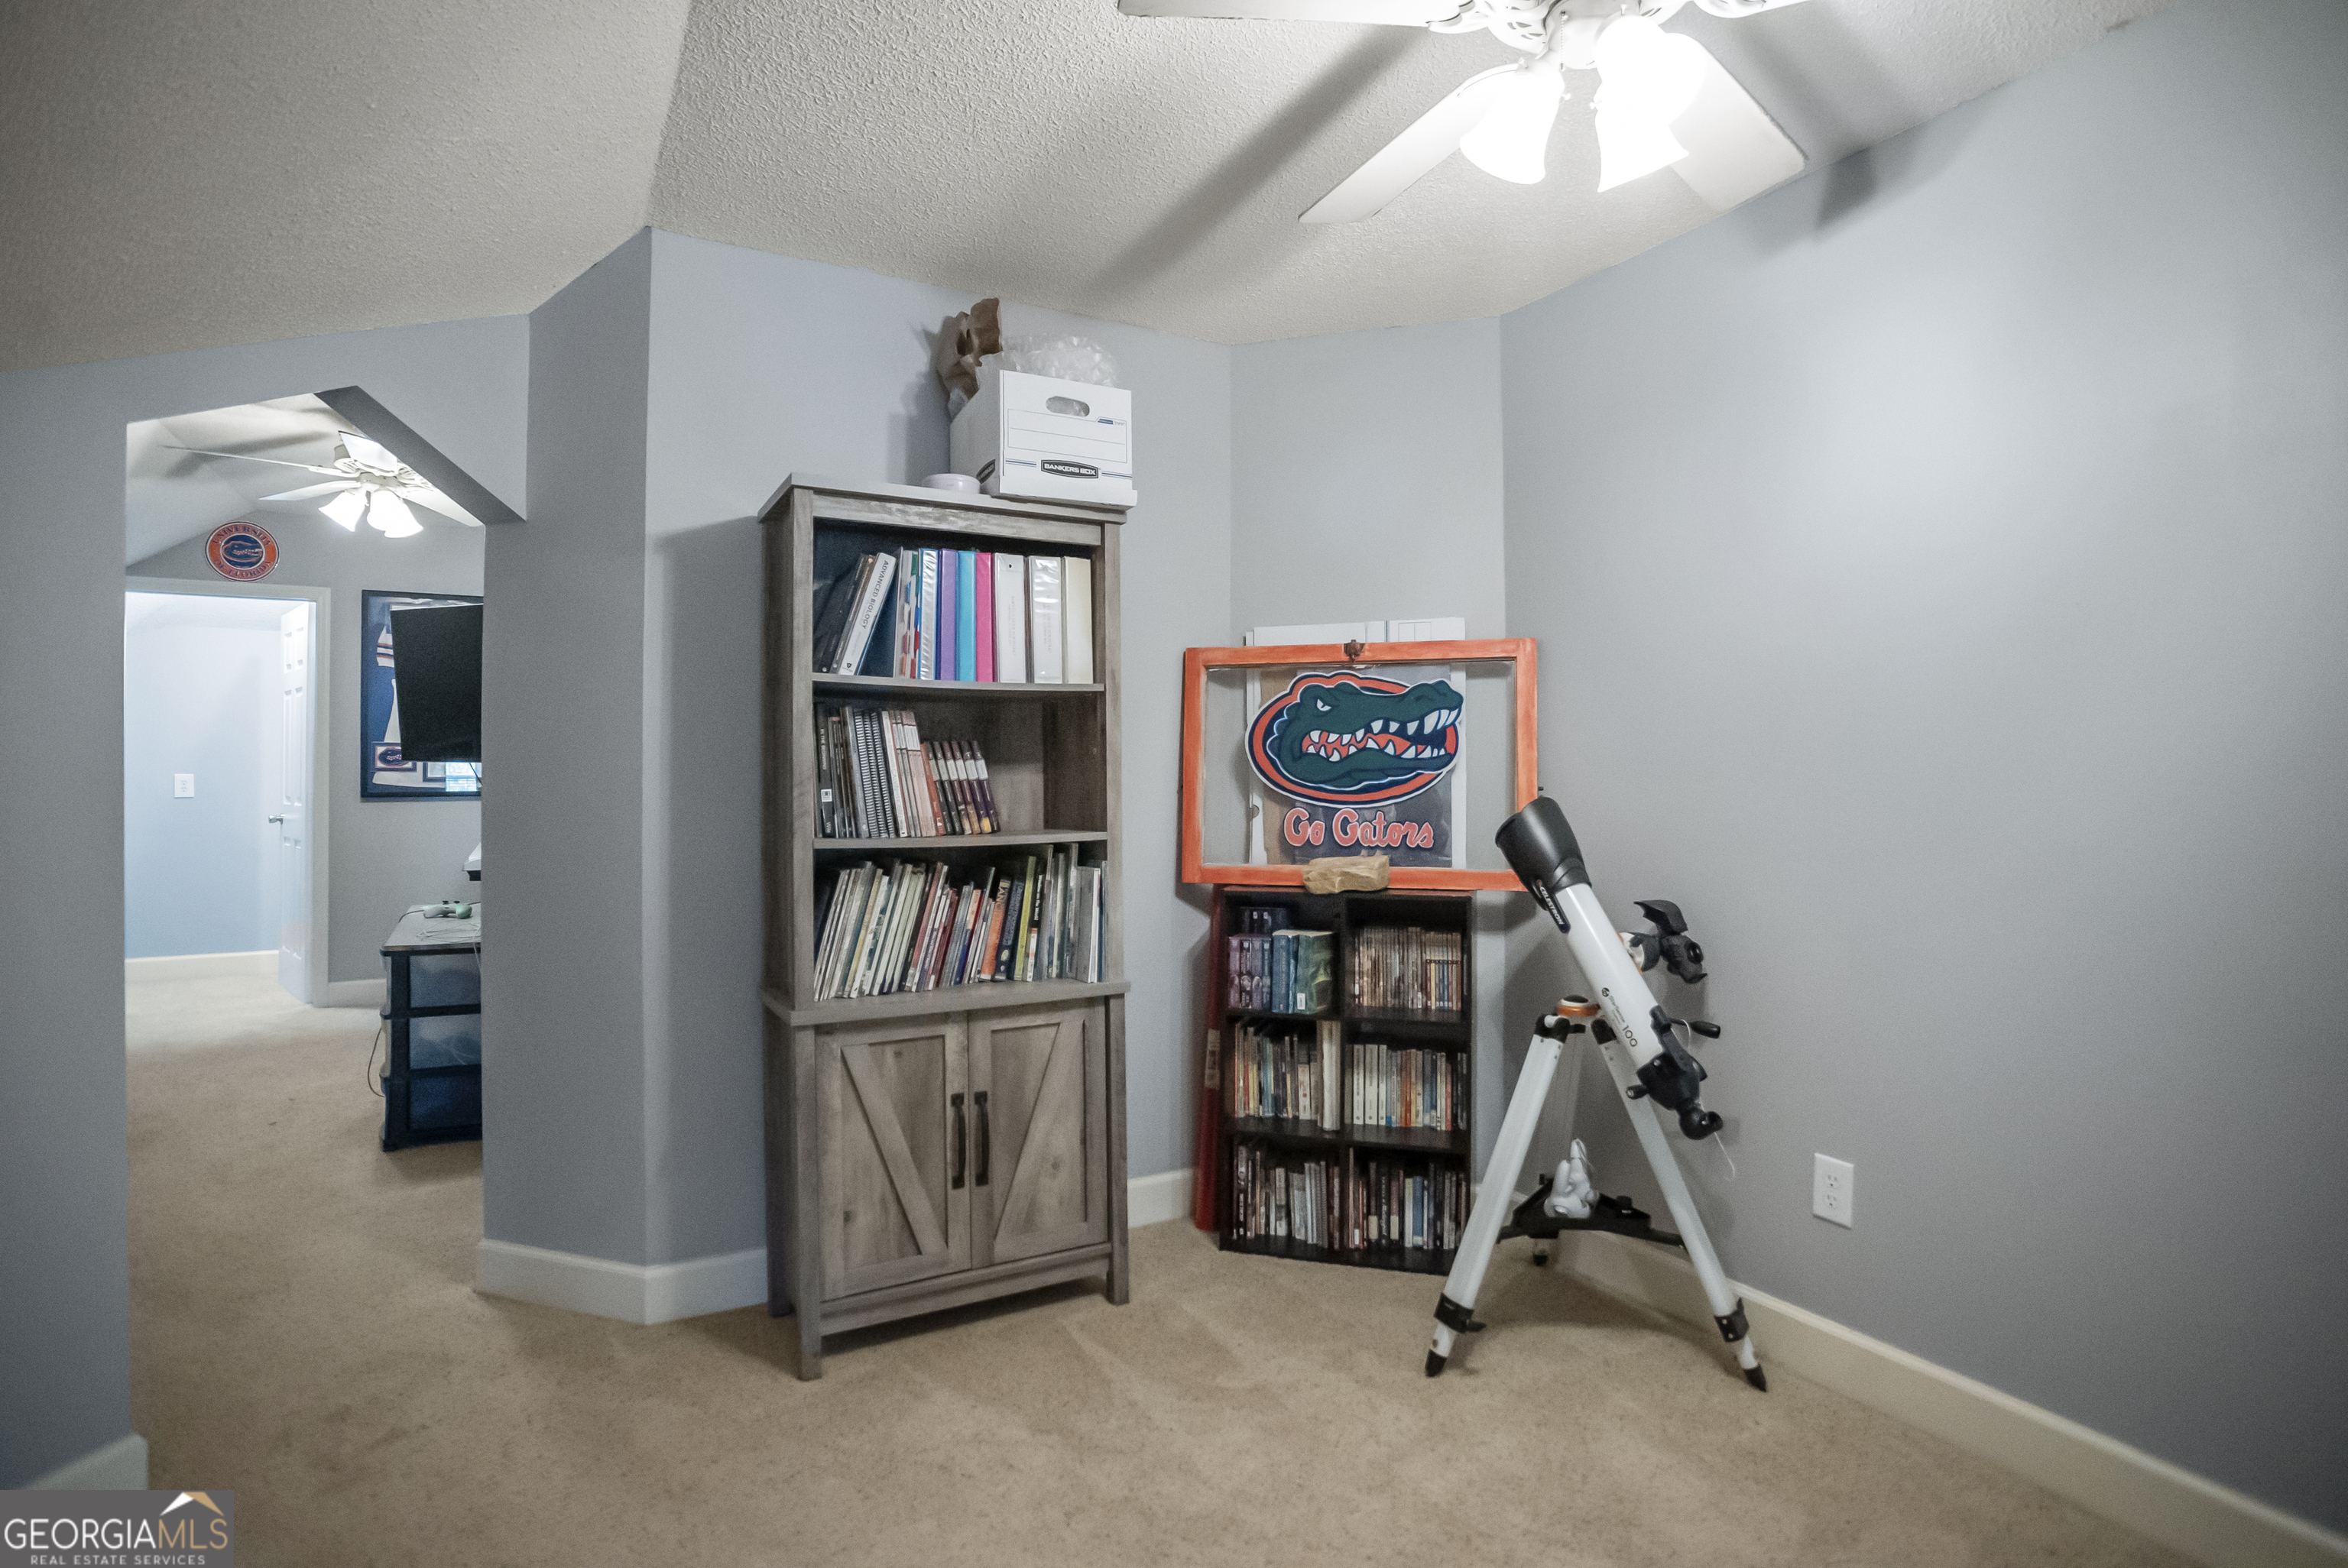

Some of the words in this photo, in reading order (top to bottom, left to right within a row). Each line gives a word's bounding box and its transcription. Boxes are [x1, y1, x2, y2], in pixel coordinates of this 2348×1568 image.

[1044, 462, 1079, 474] BANKERS
[1079, 467, 1096, 476] BOX
[872, 560, 888, 597] ADVANCED
[862, 598, 876, 628] BIOLOGY
[1284, 807, 1325, 847] Go
[1332, 807, 1435, 849] Gators
[1539, 885, 1564, 925] CELESTRON
[1622, 1024, 1638, 1048] 100
